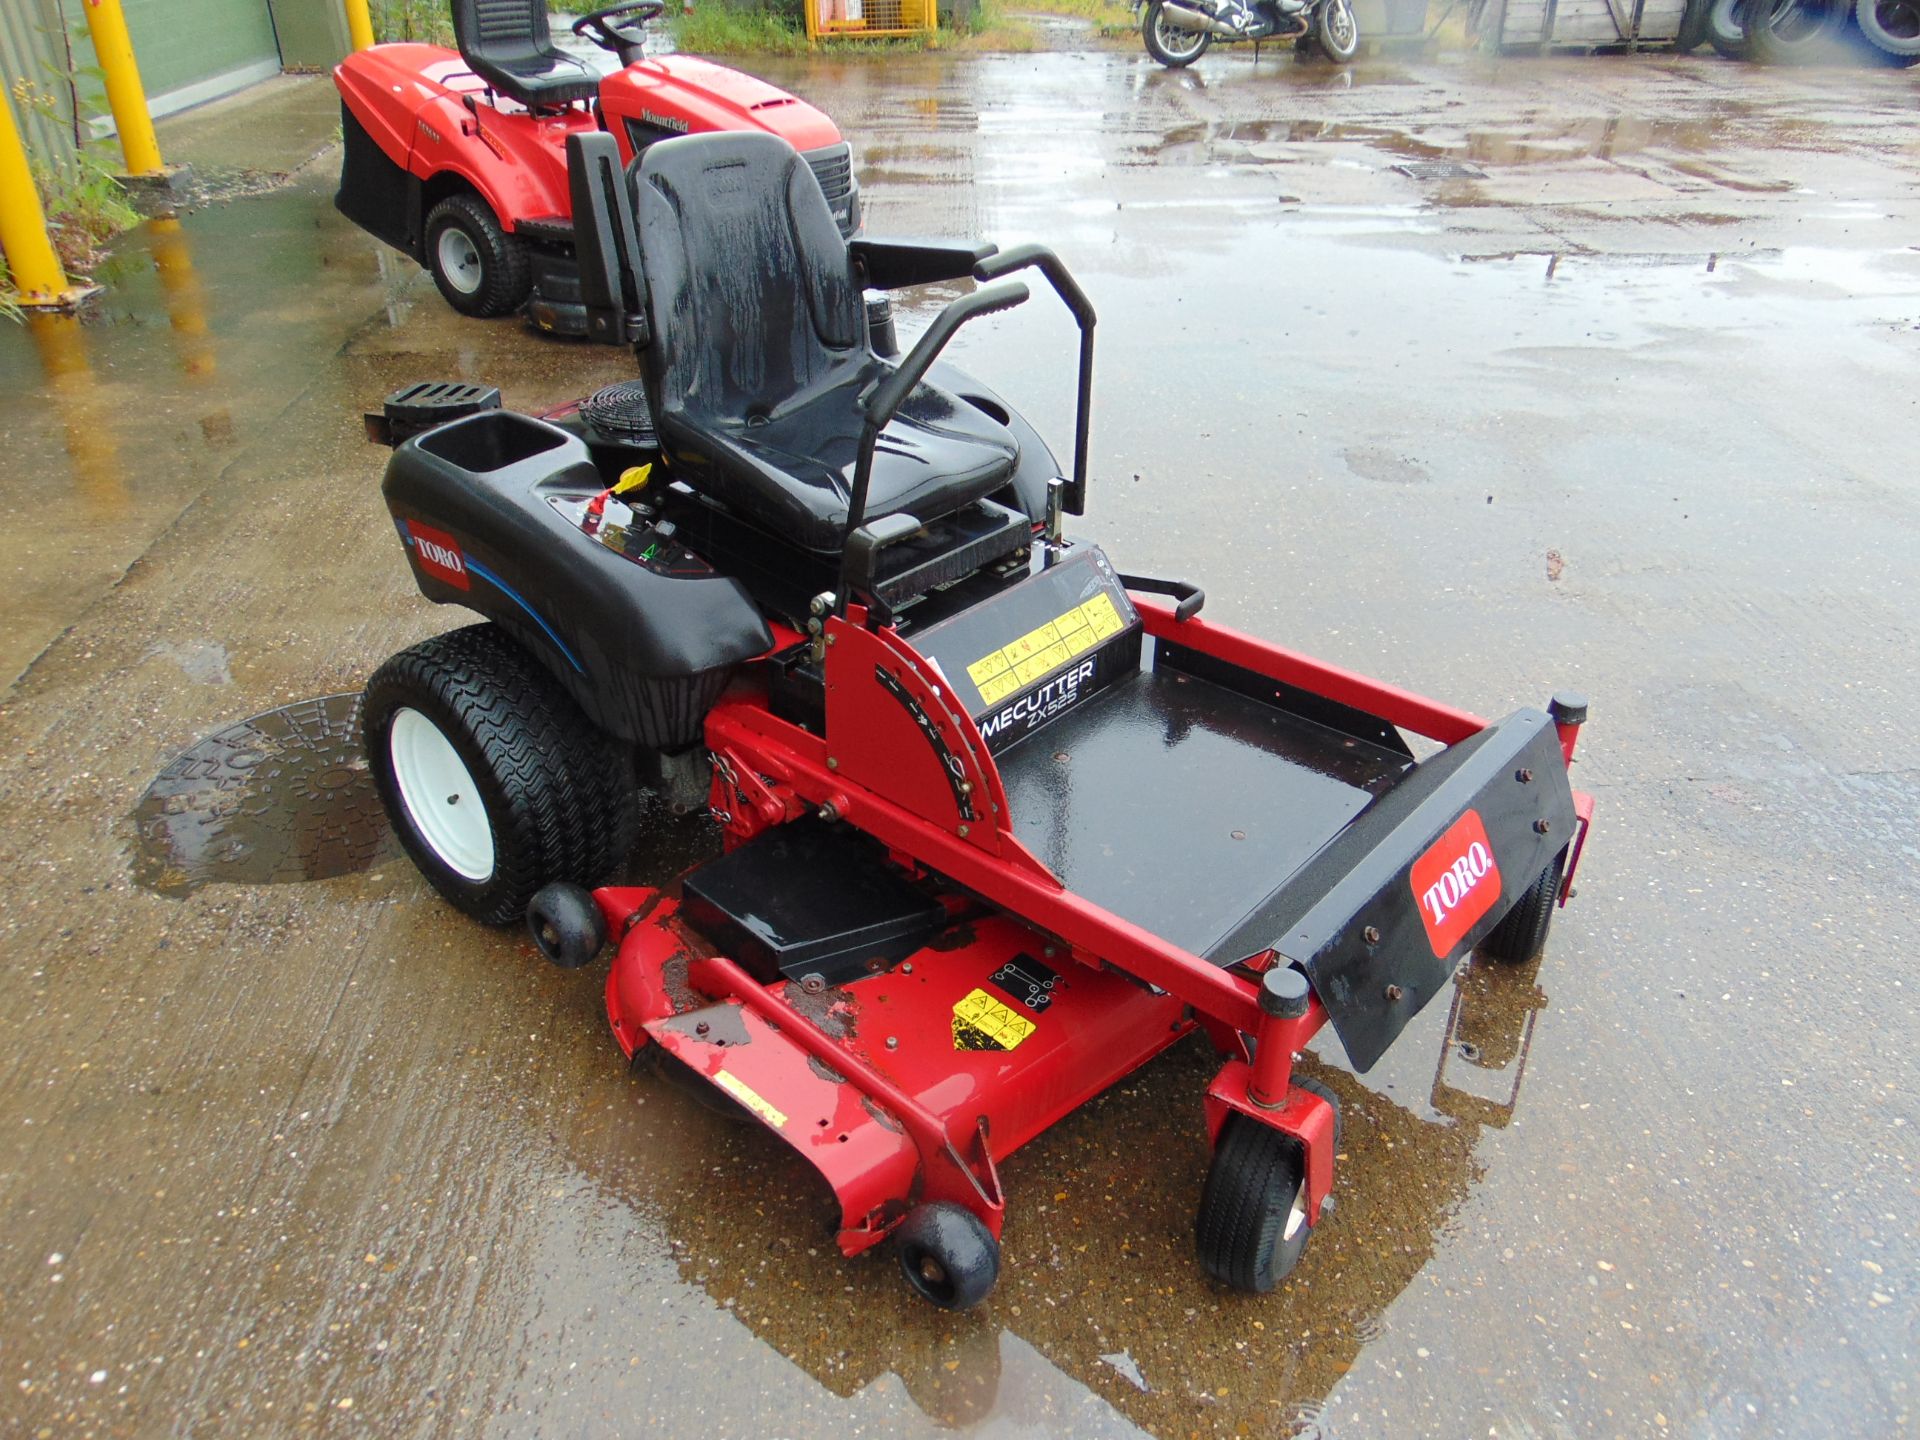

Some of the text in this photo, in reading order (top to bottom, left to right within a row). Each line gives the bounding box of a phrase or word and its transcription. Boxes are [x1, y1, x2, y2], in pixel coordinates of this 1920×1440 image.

[641, 107, 689, 133] Mountfield
[414, 536, 461, 573] TORO
[1027, 687, 1077, 729] ZX525
[1423, 841, 1487, 926] TORO
